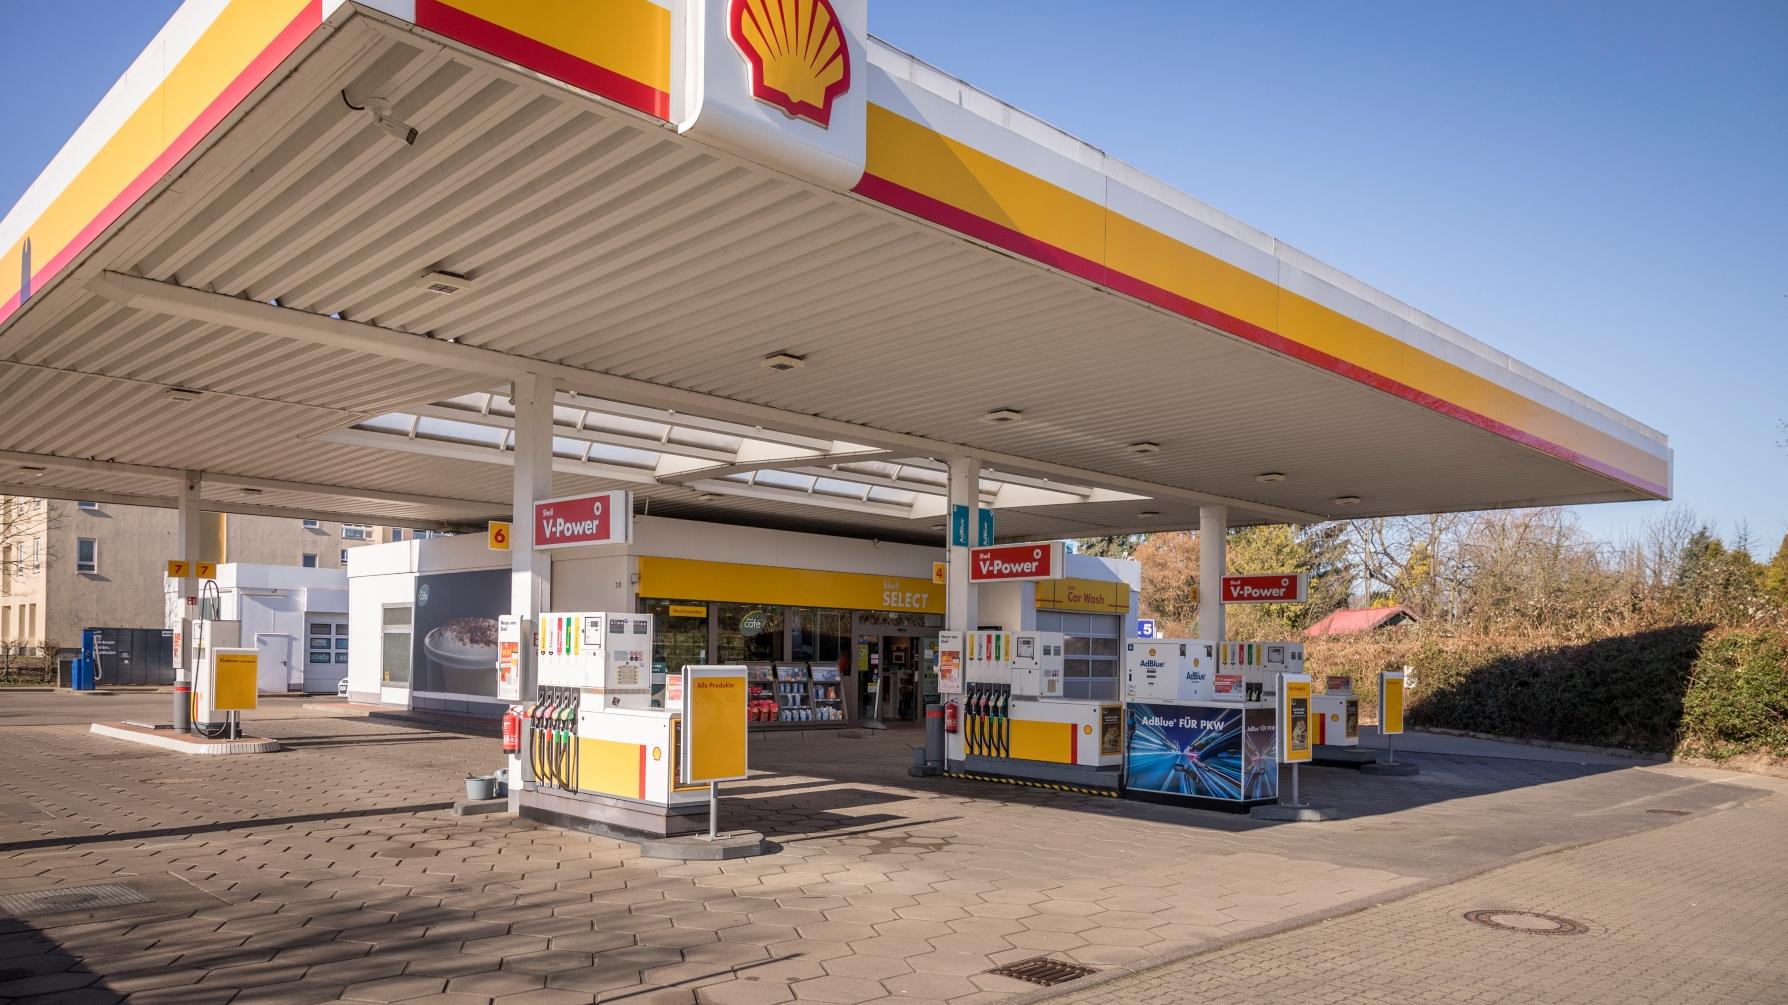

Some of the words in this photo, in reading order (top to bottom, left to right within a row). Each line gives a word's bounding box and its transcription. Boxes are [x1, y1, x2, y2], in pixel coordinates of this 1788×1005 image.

[543, 518, 599, 538] V-Power
[494, 529, 505, 544] 6
[174, 564, 182, 574] 7
[201, 566, 208, 575] 7
[936, 568, 942, 578] 4
[980, 560, 1038, 576] V-Power
[1068, 592, 1082, 602] Car
[1084, 593, 1104, 604] Wash
[1230, 586, 1286, 598] V-Power
[882, 592, 928, 609] SELECT
[744, 618, 761, 630] café
[1179, 716, 1198, 728] FÜR
[1200, 720, 1225, 730] PKW
